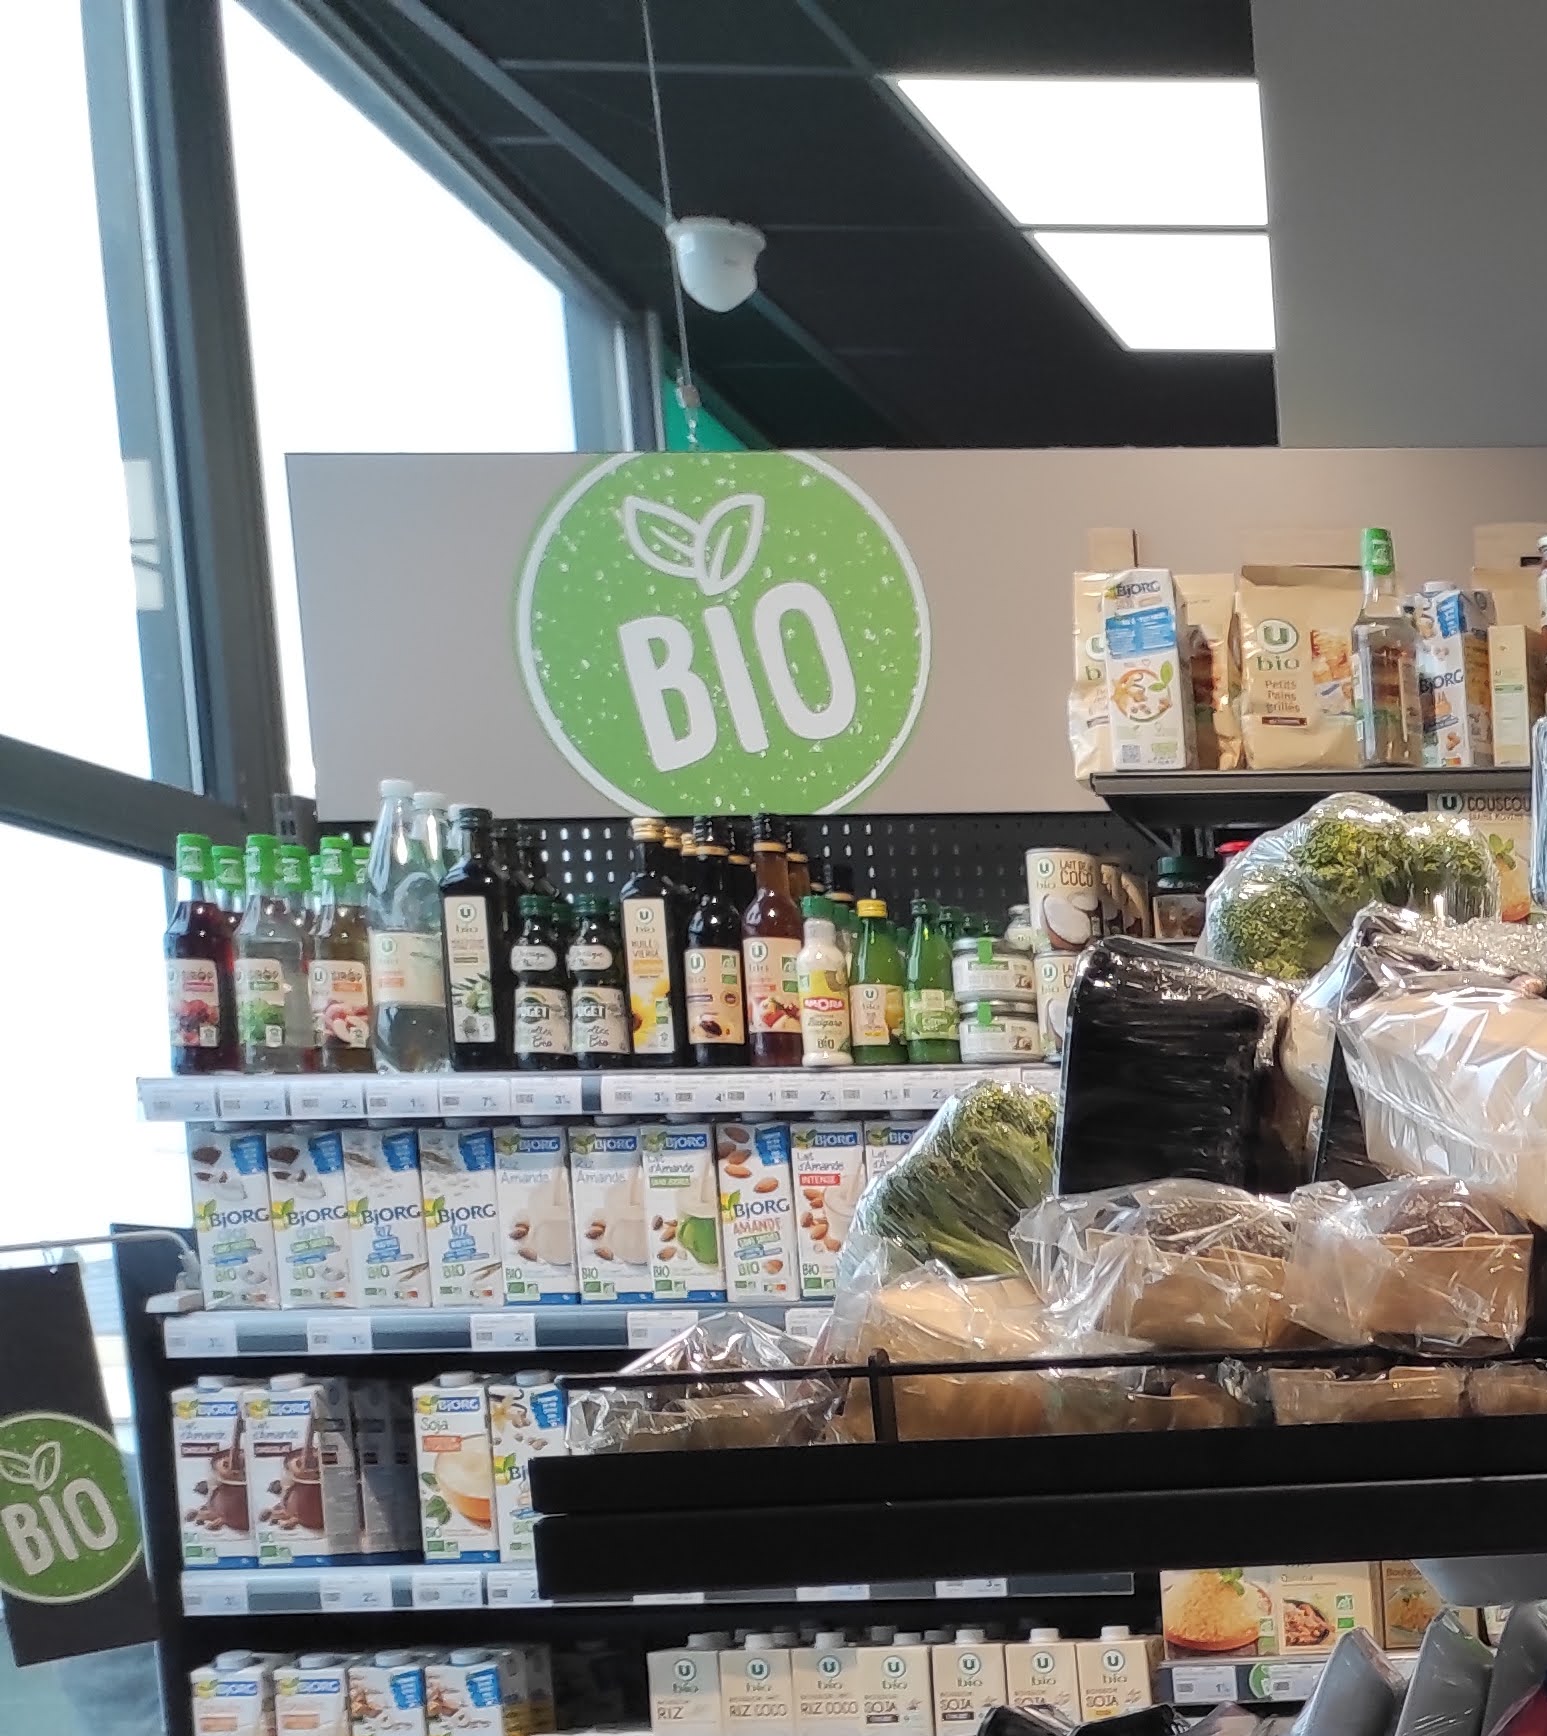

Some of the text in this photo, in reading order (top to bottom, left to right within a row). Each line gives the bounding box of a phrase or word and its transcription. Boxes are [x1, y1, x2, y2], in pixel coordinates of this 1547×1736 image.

[1256, 657, 1300, 672] bio
[617, 581, 860, 774] BIO
[1060, 868, 1095, 887] COCO
[420, 1417, 448, 1432] Soja
[1, 1474, 120, 1577] BIO
